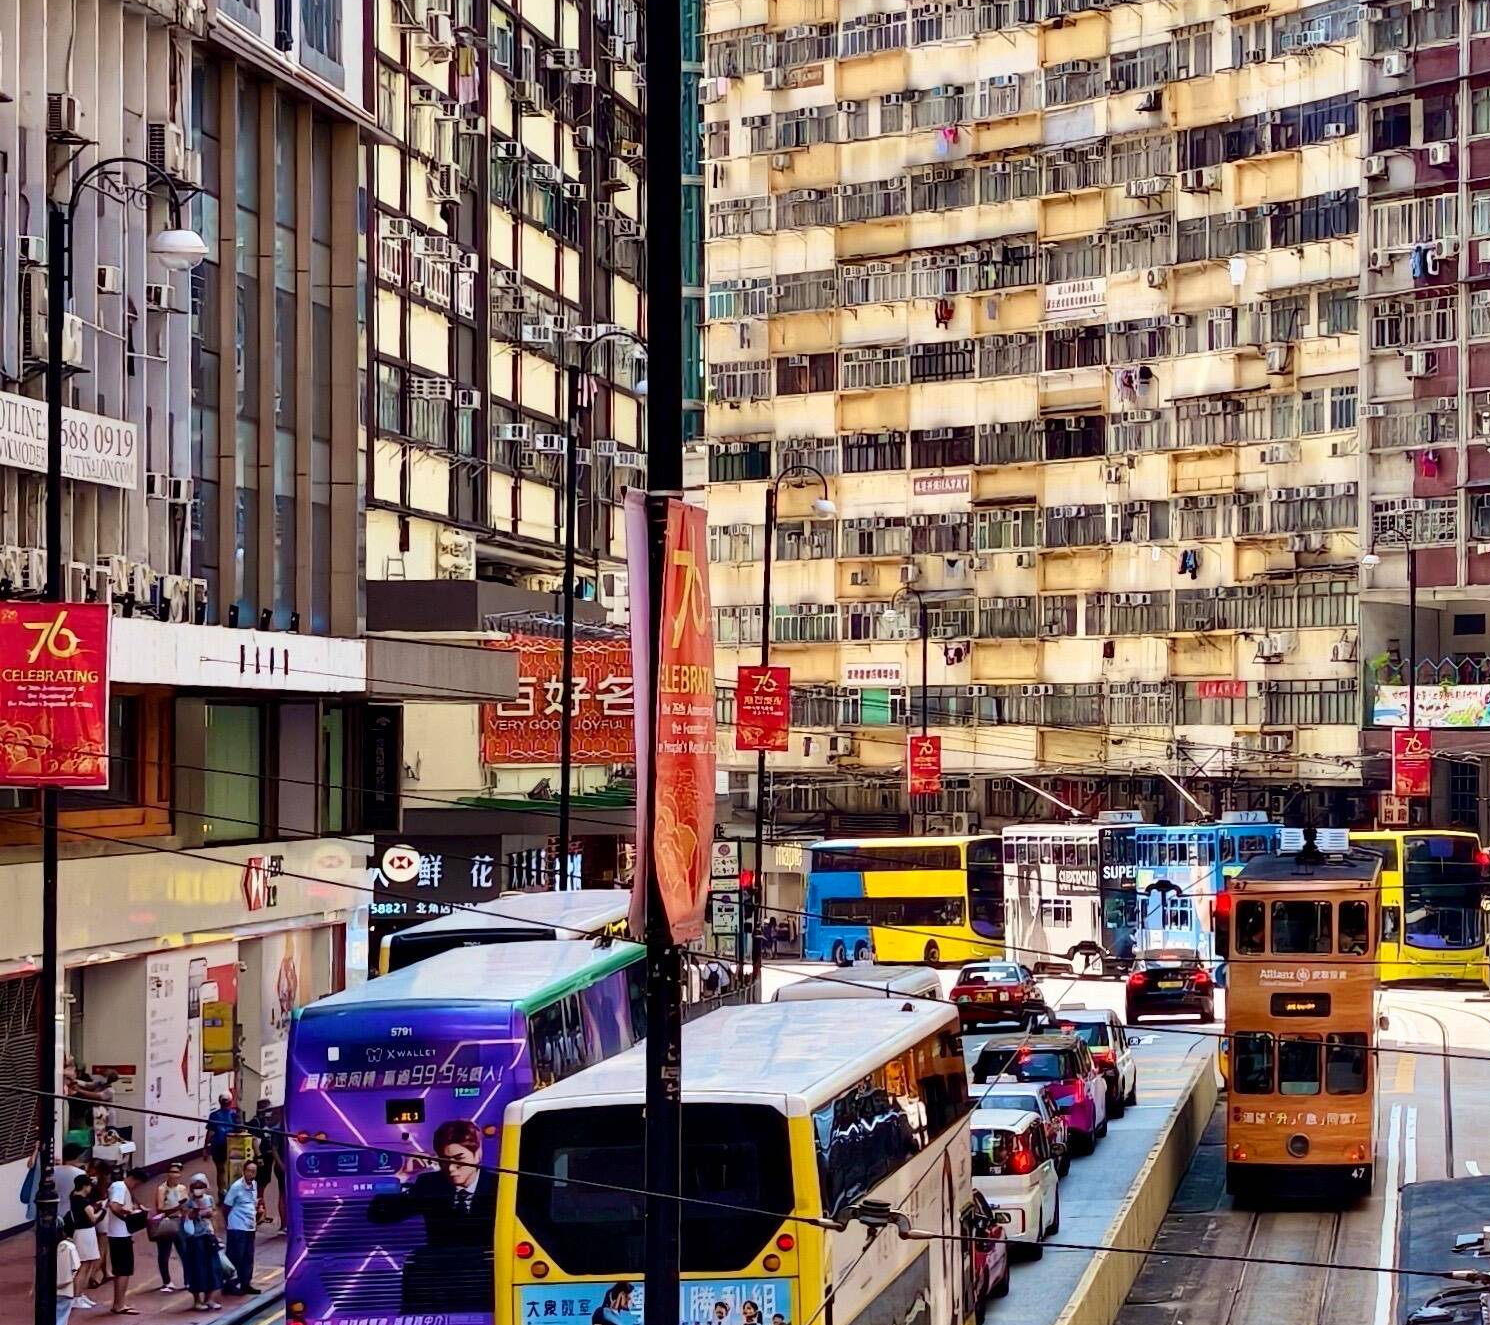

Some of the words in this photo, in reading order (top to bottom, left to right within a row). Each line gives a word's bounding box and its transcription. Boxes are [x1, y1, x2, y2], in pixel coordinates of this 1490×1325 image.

[94, 424, 133, 457] 0919
[23, 610, 78, 664] 76
[2, 669, 99, 683] CELEBRATING
[489, 720, 527, 731] VERY
[574, 720, 625, 731] JOYFUL
[368, 854, 495, 889] 鮮花
[391, 1027, 413, 1037] 5791
[1351, 1167, 1366, 1179] 47
